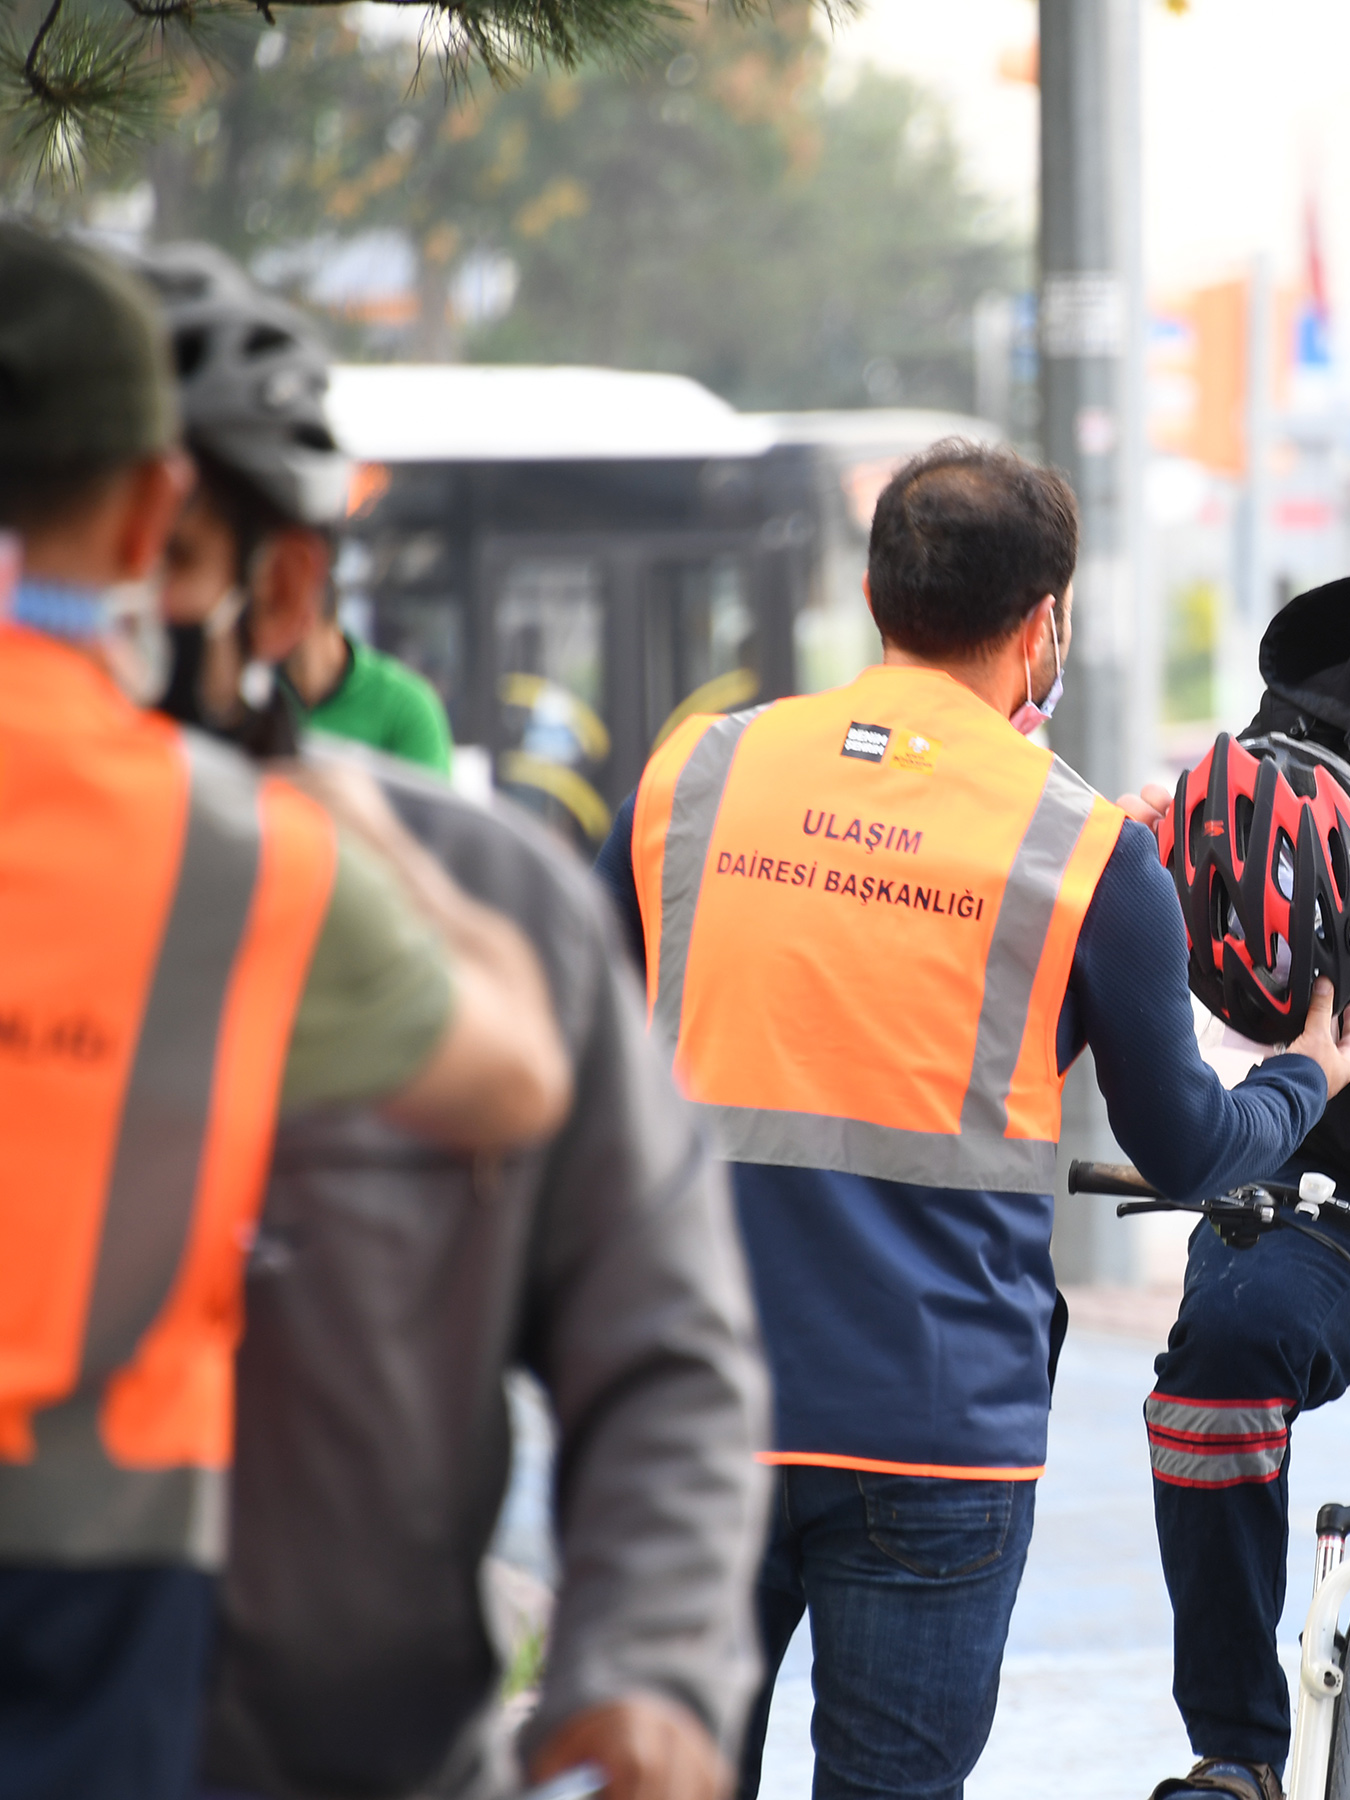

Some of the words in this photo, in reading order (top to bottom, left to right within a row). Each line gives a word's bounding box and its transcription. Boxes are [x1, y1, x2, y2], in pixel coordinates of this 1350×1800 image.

[802, 809, 923, 854] ULAŞIM
[716, 850, 818, 889] DAİRESİ
[824, 870, 985, 921] BAŞKANLIĞI
